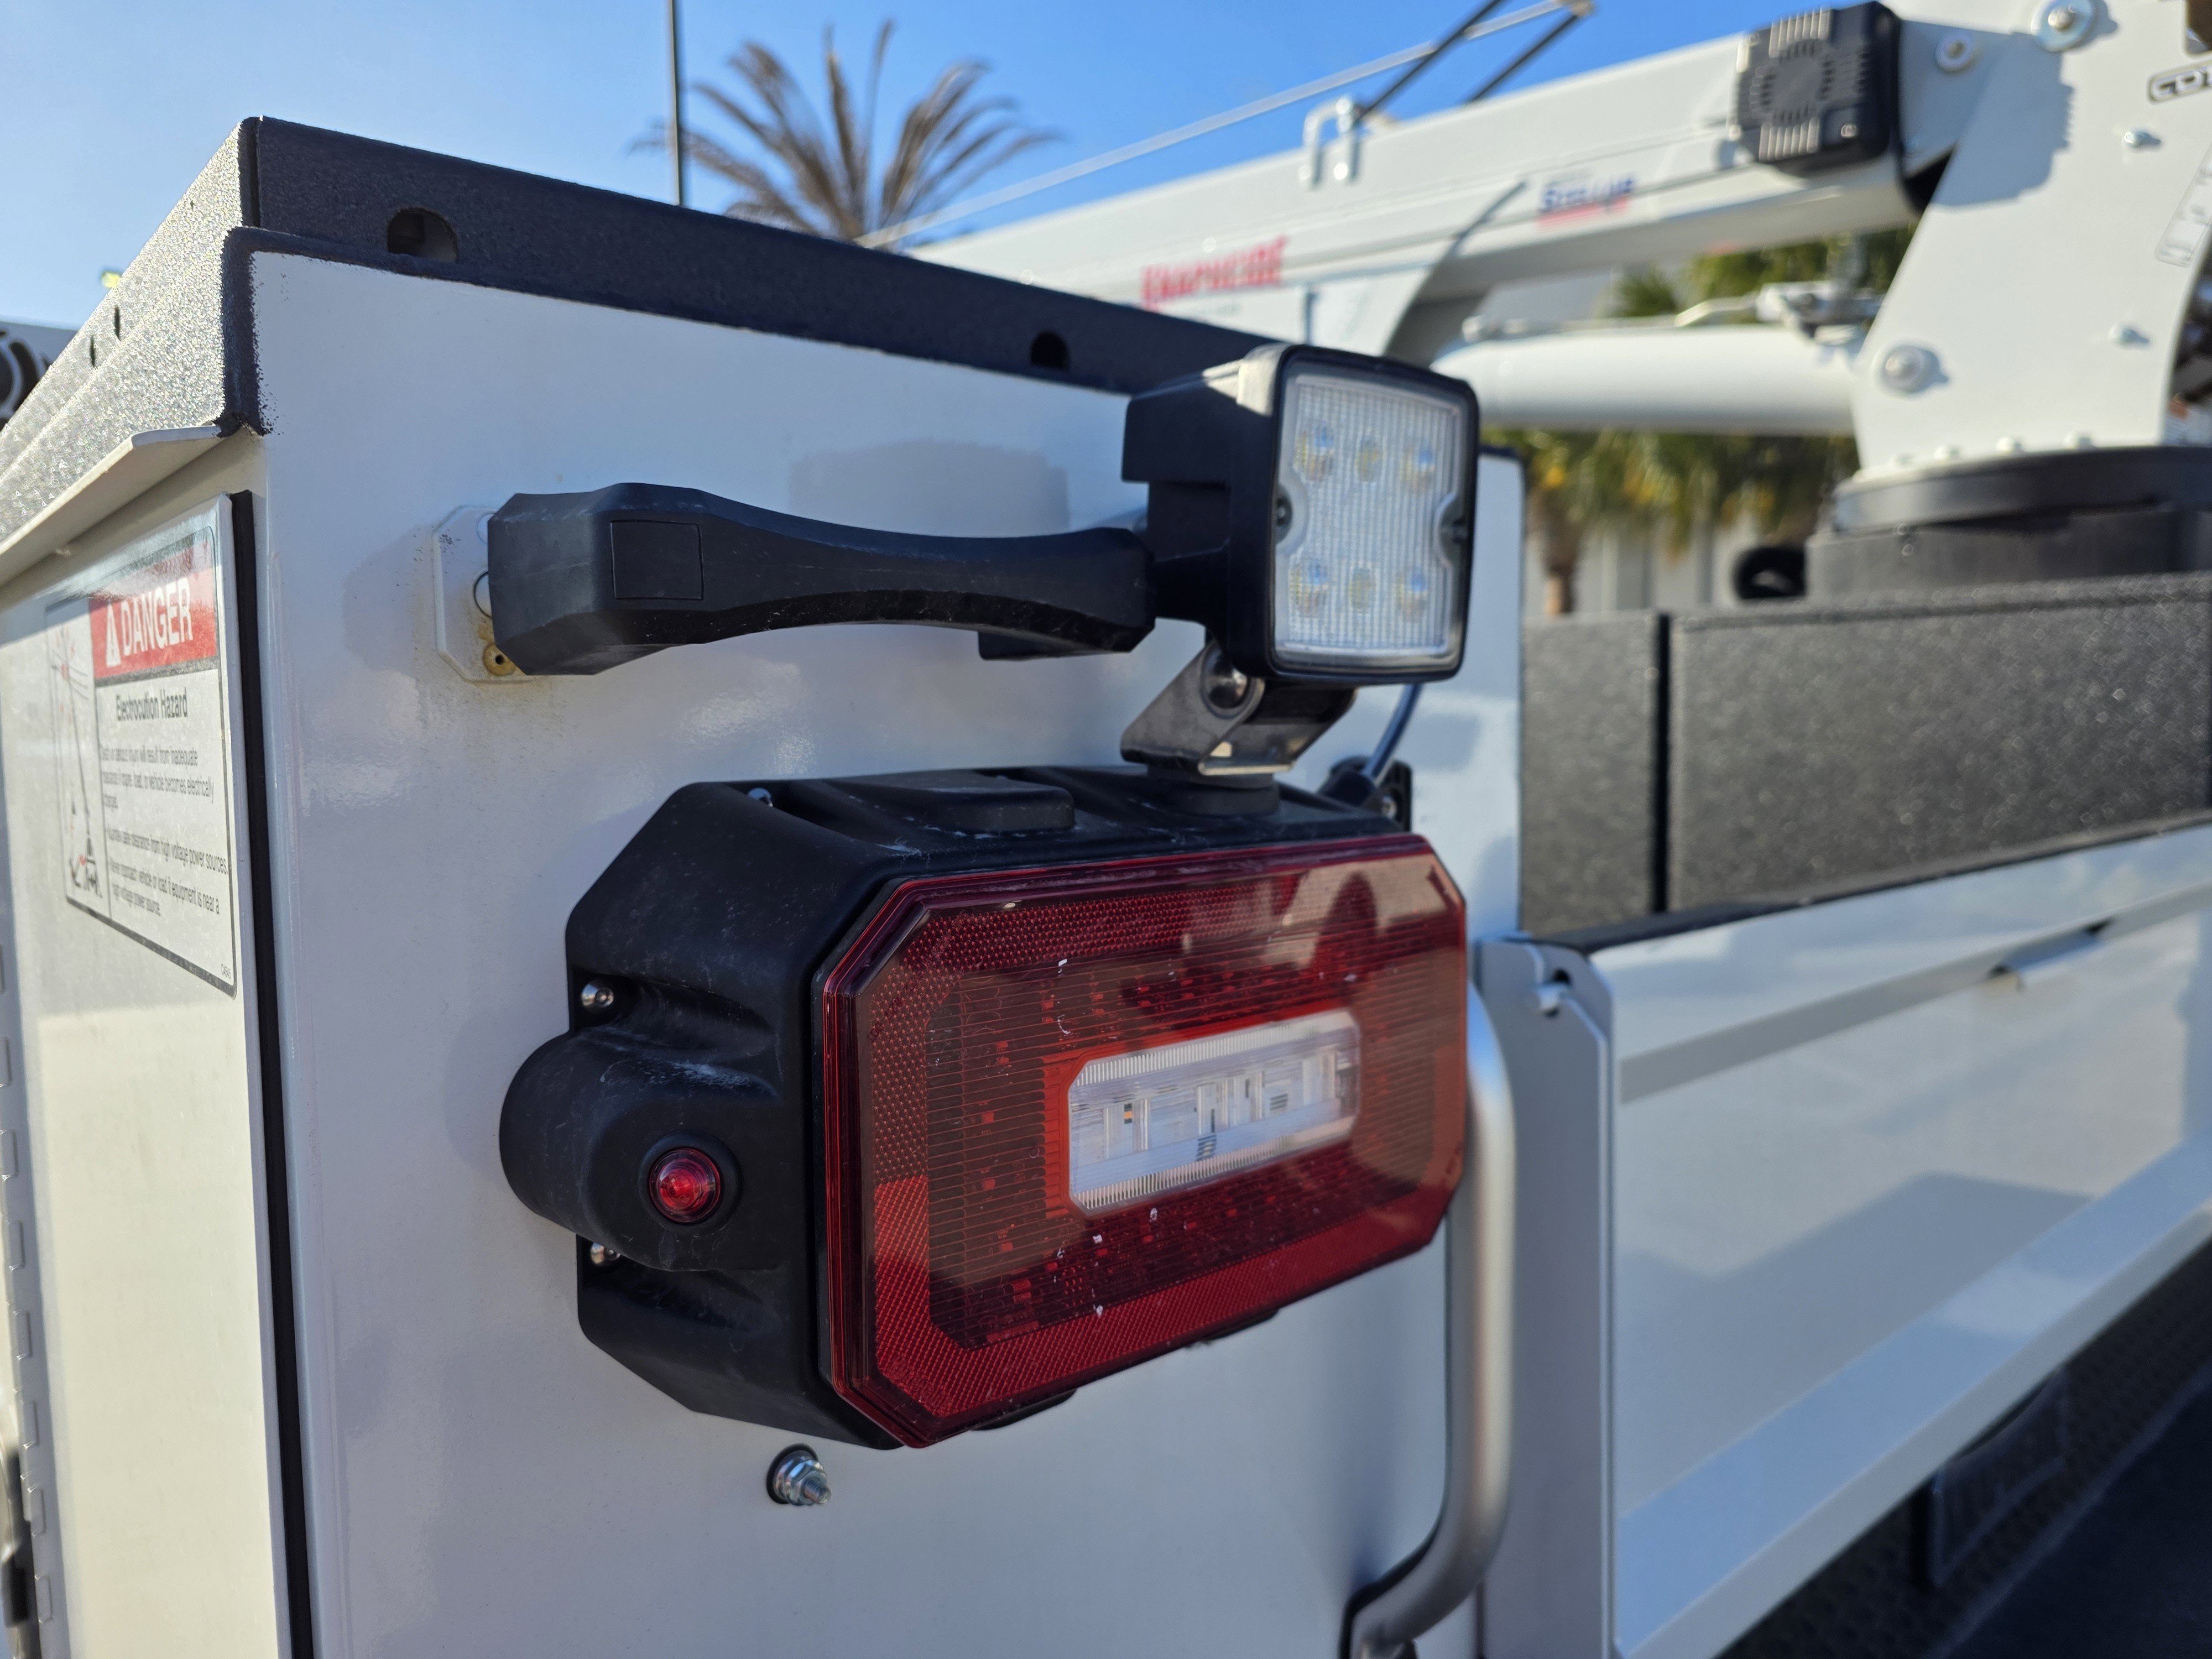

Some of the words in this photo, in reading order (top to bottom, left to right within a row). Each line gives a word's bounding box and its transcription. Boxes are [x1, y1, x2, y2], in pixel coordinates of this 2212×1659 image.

[121, 577, 192, 656] DANGER
[116, 691, 159, 721] Electrocution
[160, 686, 188, 719] Hazard
[170, 746, 198, 771] inadequate
[165, 774, 186, 795] becomes
[187, 775, 214, 804] electrically
[171, 841, 188, 867] voltage
[189, 849, 205, 869] power
[206, 853, 228, 875] sources.
[172, 881, 197, 905] equipment
[197, 886, 202, 907] is
[202, 893, 215, 912] near
[216, 898, 220, 915] a
